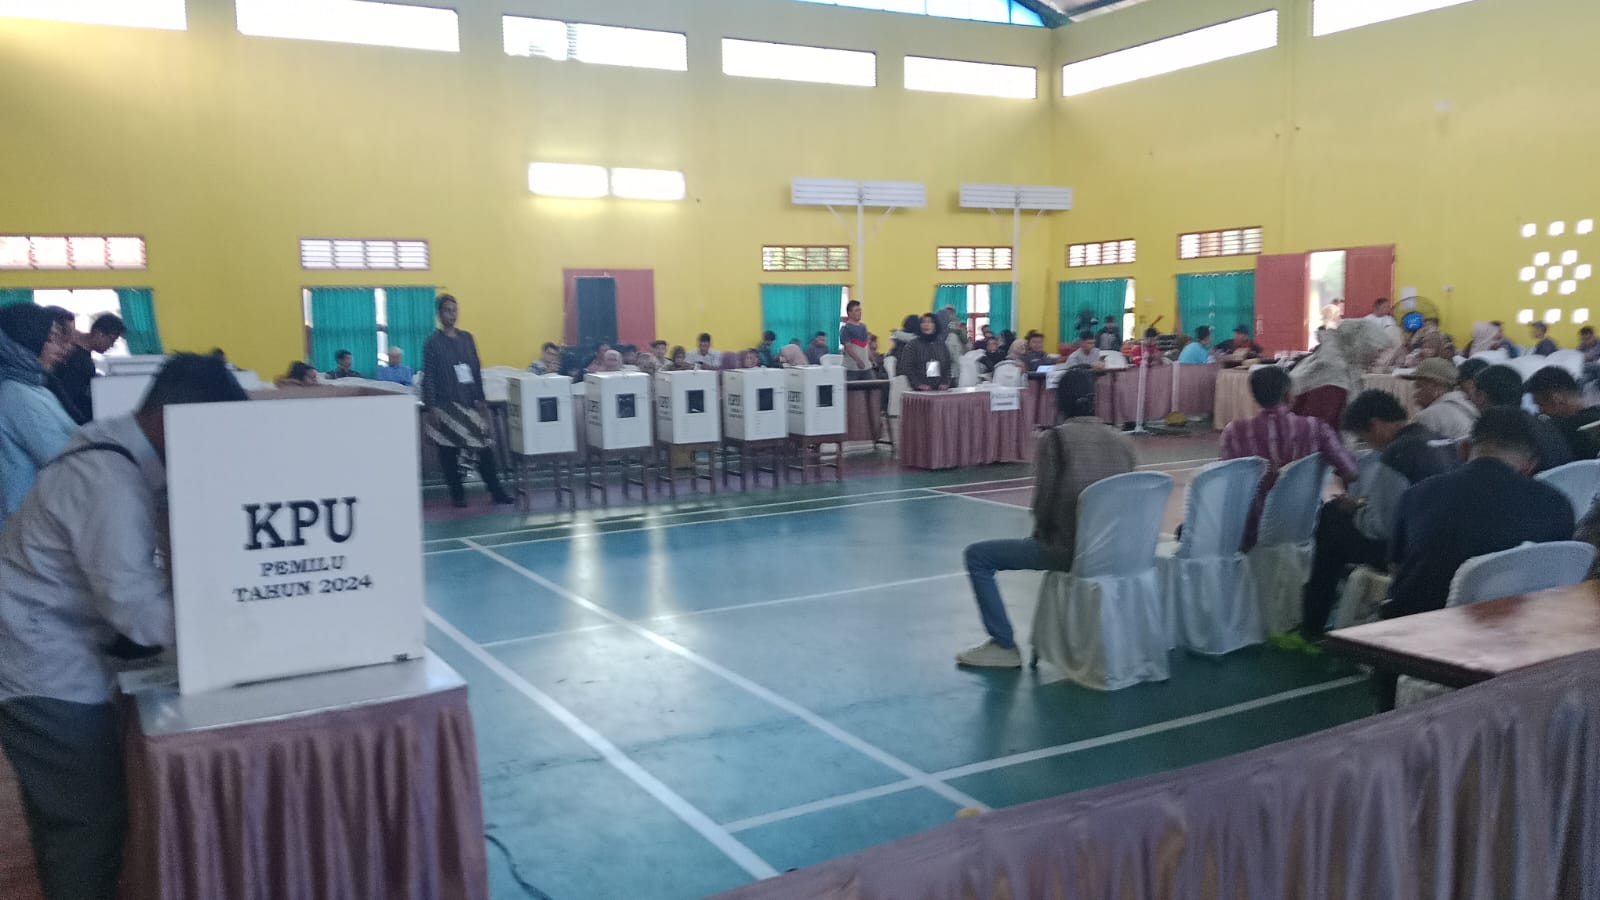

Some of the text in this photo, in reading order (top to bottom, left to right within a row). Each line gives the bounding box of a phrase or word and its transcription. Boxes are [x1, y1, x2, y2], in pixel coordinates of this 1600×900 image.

[242, 496, 357, 550] KPU
[261, 556, 345, 576] PEMILU
[232, 574, 372, 602] TAHUN 2024
